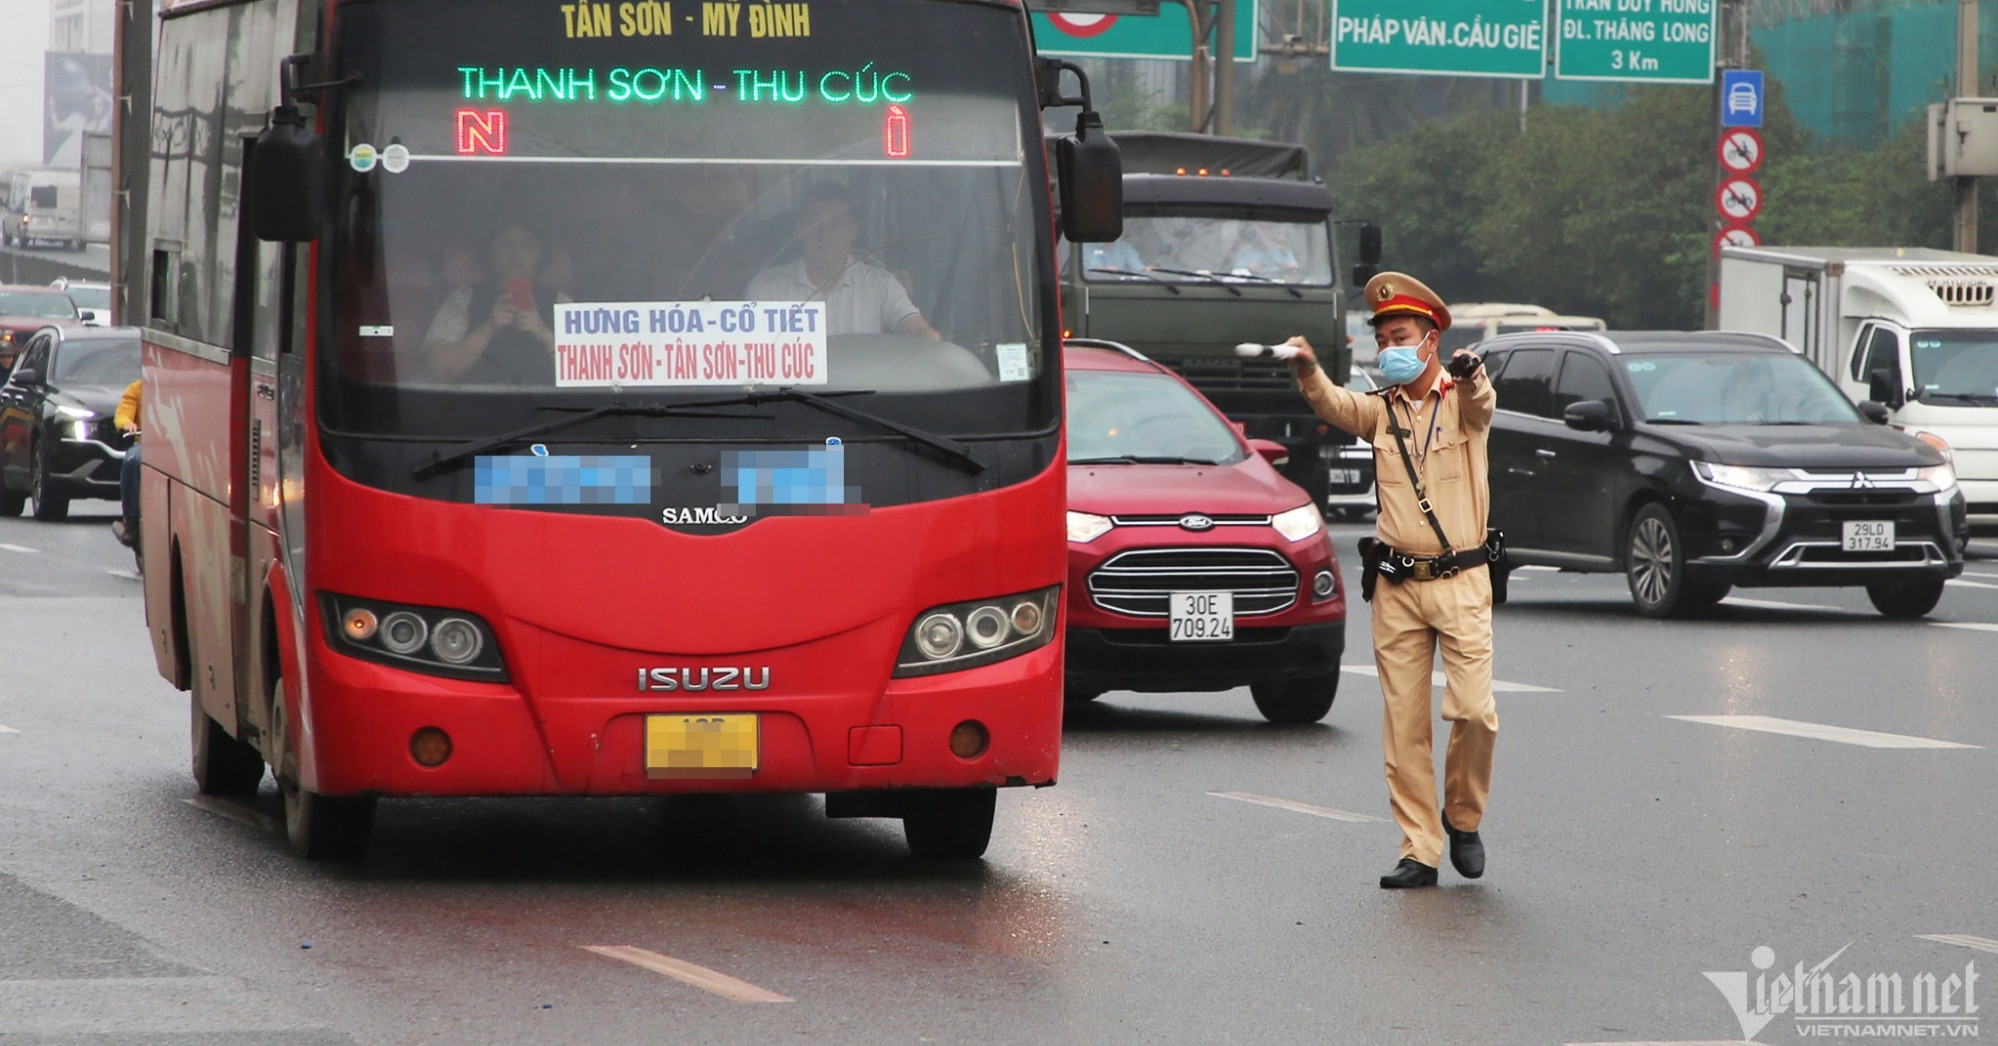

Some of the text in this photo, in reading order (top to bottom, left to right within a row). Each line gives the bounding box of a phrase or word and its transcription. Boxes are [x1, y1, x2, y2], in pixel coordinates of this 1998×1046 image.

[561, 0, 612, 38] TÂN
[619, 0, 672, 38] SƠN
[749, 0, 810, 37] ĐÌNH
[1338, 14, 1400, 44] PHÁP
[1594, 17, 1655, 41] THĂNG
[1663, 22, 1709, 43] LONG
[1611, 50, 1658, 70] 3 Km
[457, 67, 594, 100] THANH
[609, 67, 701, 101] SƠN
[733, 69, 804, 101] THU
[820, 61, 912, 102] CÚC
[458, 111, 505, 154] N
[565, 308, 640, 334] HƯNG
[764, 302, 819, 333] TIẾT
[557, 345, 613, 380] THANH
[781, 337, 815, 379] CÚC
[1849, 537, 1889, 550] 317.94
[1186, 594, 1218, 615] 30E
[1172, 617, 1230, 638] 709.24
[638, 667, 769, 692] ISUZU
